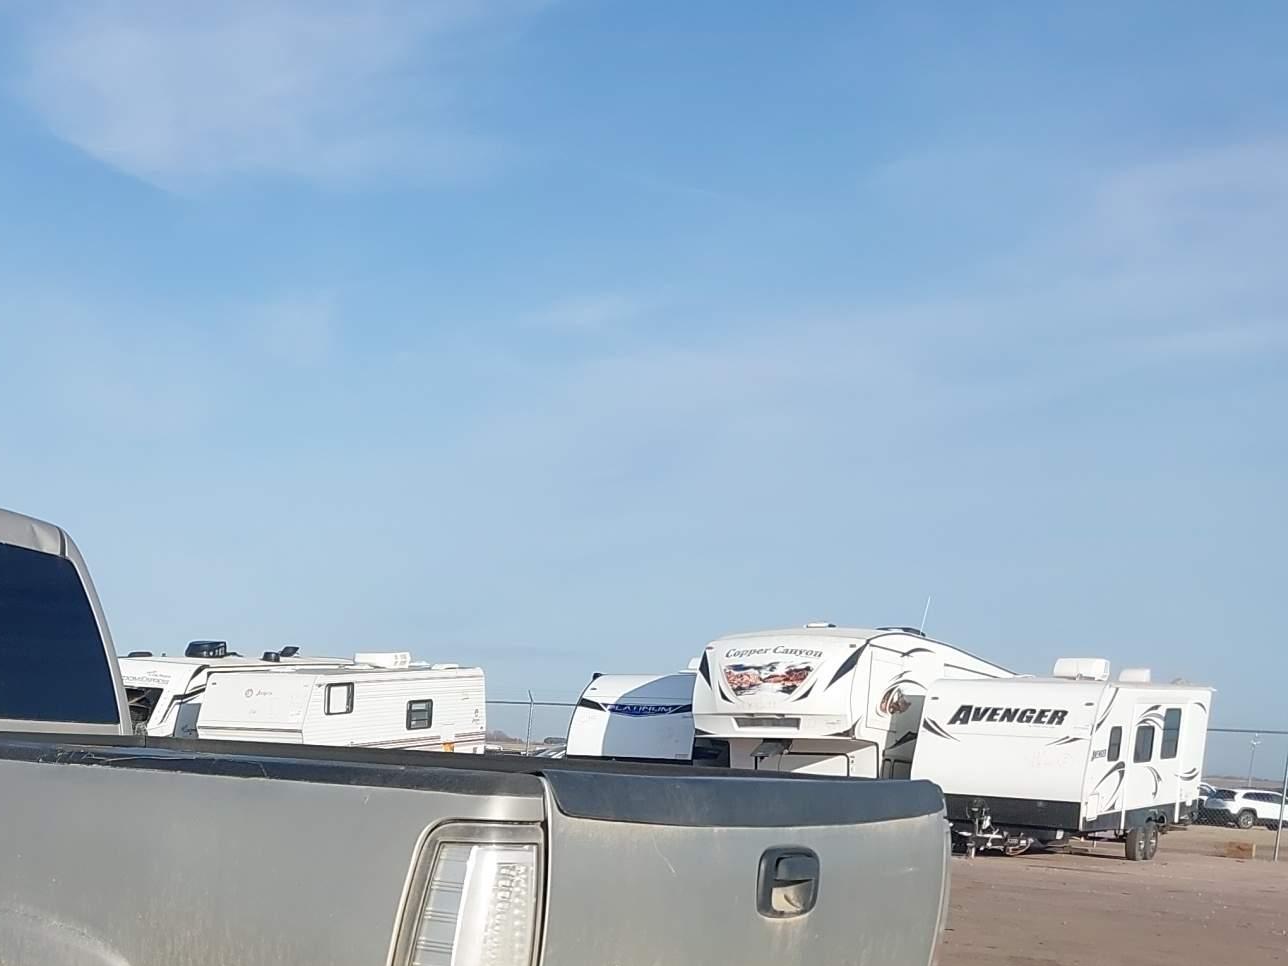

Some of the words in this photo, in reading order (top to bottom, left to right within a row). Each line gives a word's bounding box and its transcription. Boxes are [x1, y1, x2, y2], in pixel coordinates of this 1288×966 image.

[725, 647, 771, 659] Copper
[772, 645, 824, 658] Canyon
[607, 703, 674, 714] PLATINUM
[946, 704, 1070, 726] AVENGER
